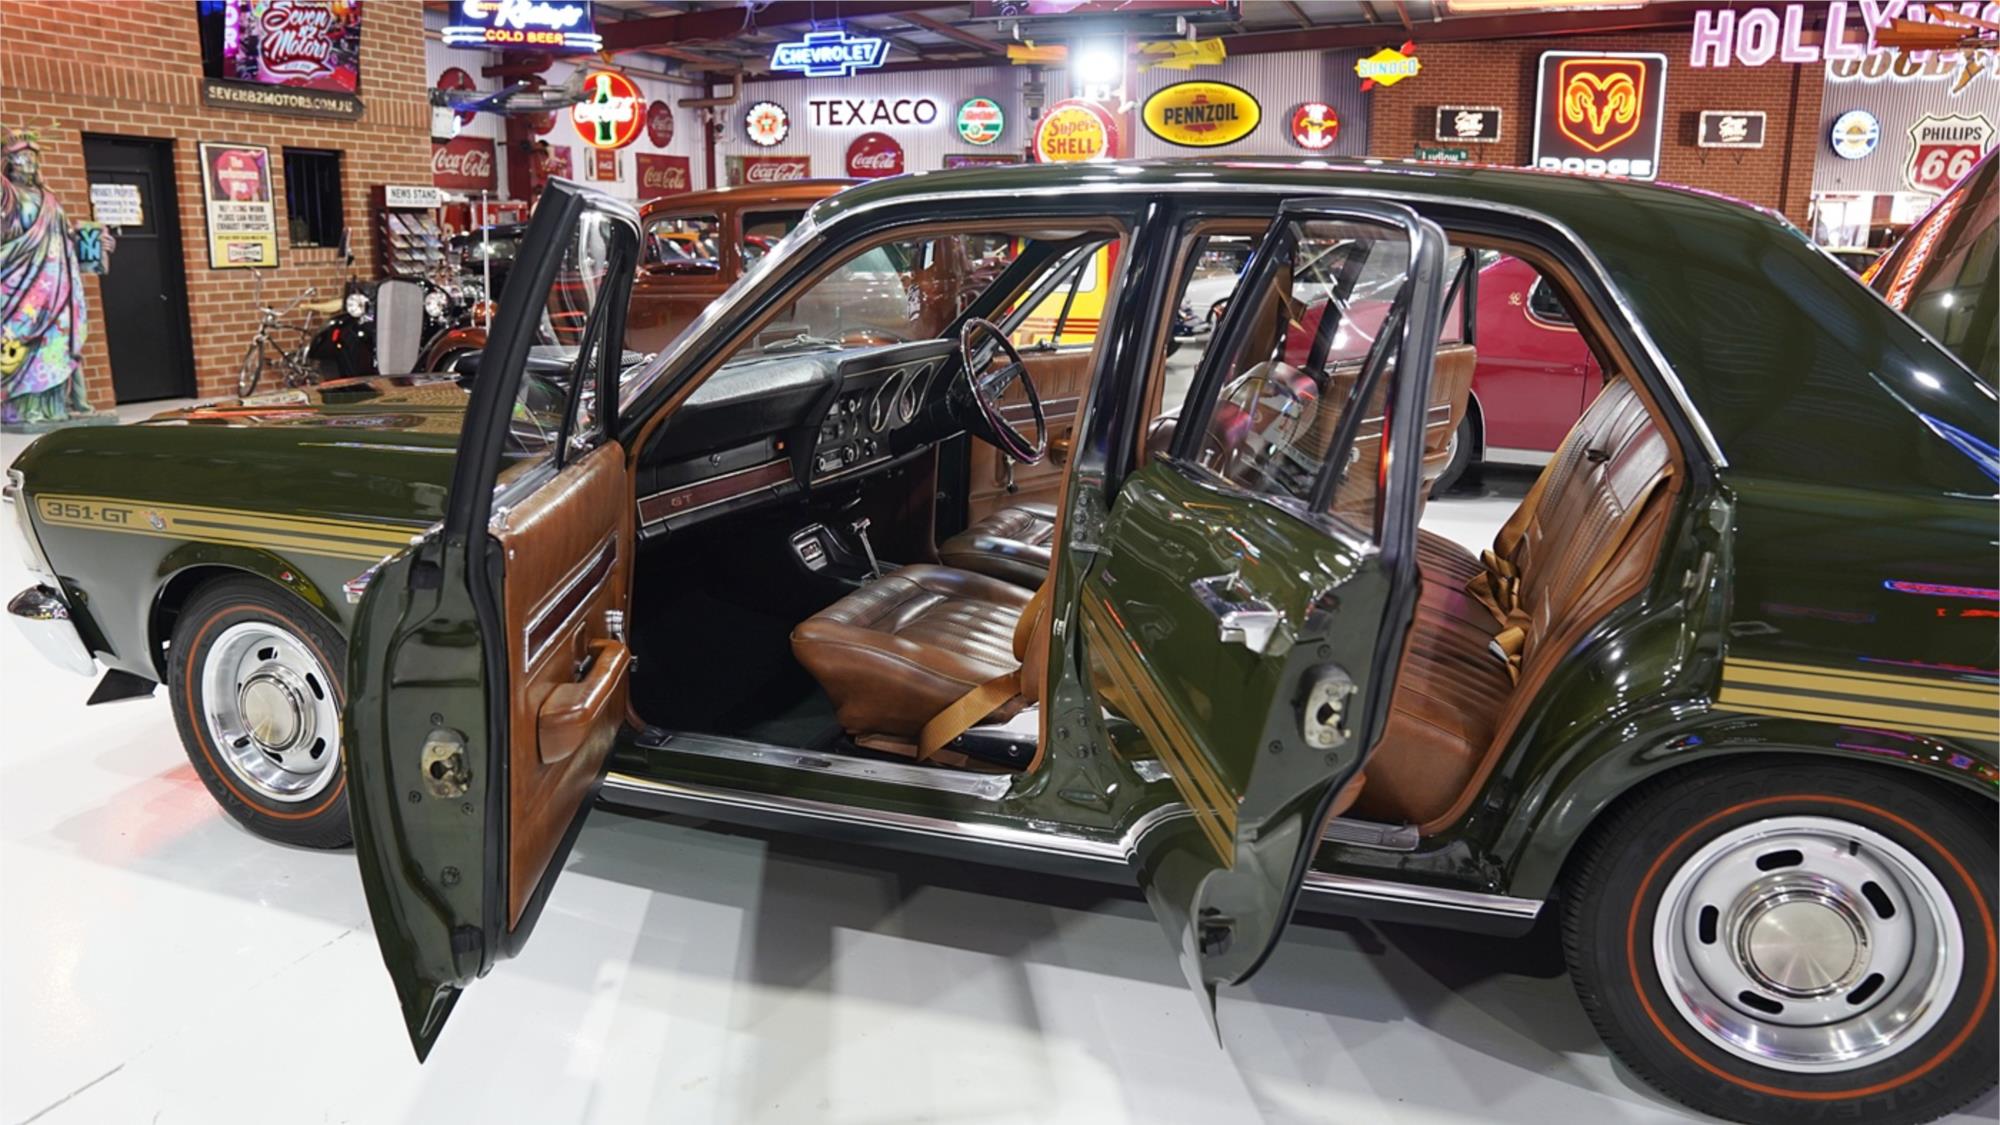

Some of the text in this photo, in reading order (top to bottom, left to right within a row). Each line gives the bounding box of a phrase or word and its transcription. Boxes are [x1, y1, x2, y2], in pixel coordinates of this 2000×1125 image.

[263, 1, 329, 31] Seven
[264, 30, 328, 59] Motors
[485, 29, 564, 46] COLD BEER
[779, 45, 873, 65] CHEVROLET
[1359, 59, 1416, 75] SUNOCO
[809, 99, 937, 126] TEXACO
[1164, 103, 1238, 126] PENNZOIL
[1921, 126, 1983, 141] PHILLIPS
[1047, 138, 1095, 154] SHELL
[1539, 157, 1652, 176] DODGE
[1921, 149, 1976, 180] 66
[391, 189, 437, 200] NEWS STAND
[671, 493, 693, 507] GT
[47, 502, 133, 524] 351-GT
